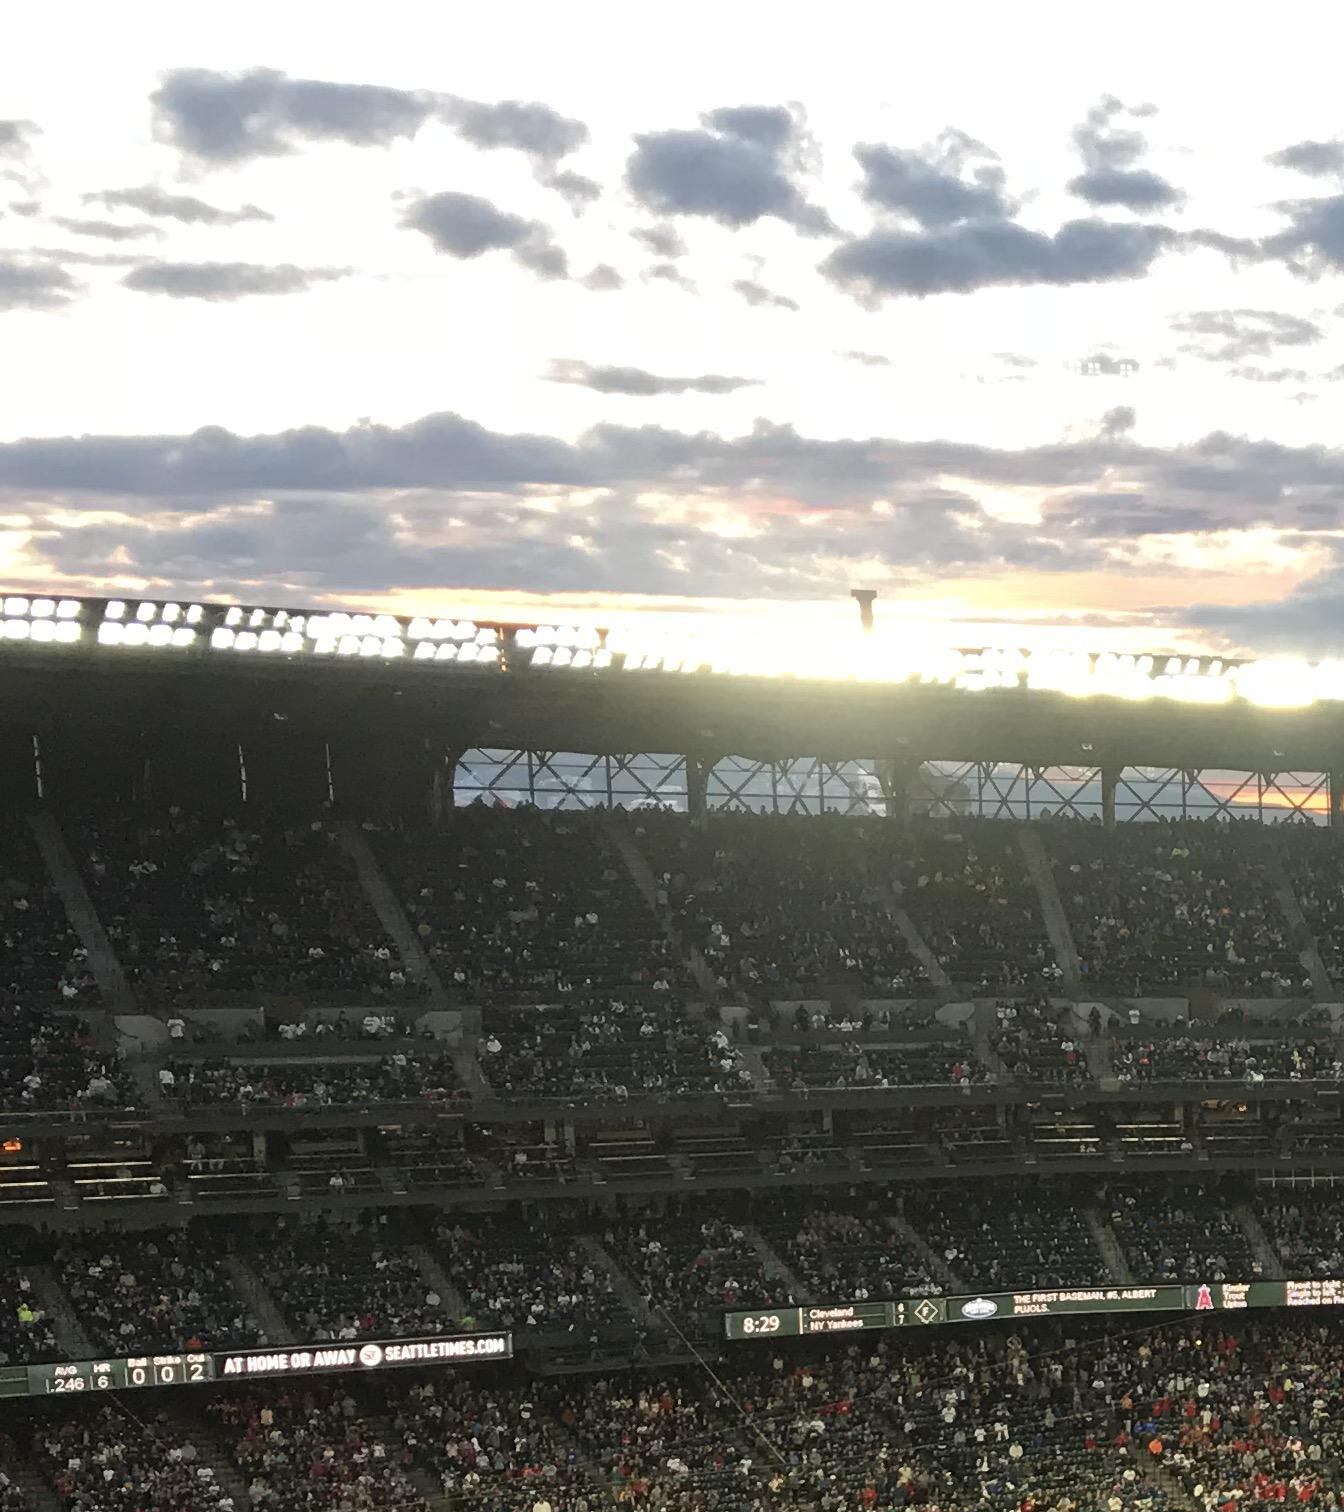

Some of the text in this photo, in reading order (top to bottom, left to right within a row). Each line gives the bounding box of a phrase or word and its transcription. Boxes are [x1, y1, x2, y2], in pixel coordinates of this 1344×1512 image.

[1122, 1289, 1157, 1299] ALBERT
[810, 1307, 854, 1318] Cleveland
[743, 1315, 780, 1333] 8:29
[826, 1319, 863, 1330] Yankees
[224, 1338, 505, 1374] AT HOME OR AWAY SEATTLETIMES.COM
[55, 1363, 111, 1376] AVG HR
[132, 1364, 204, 1385] 0 0 2
[51, 1376, 109, 1393] .246 6
